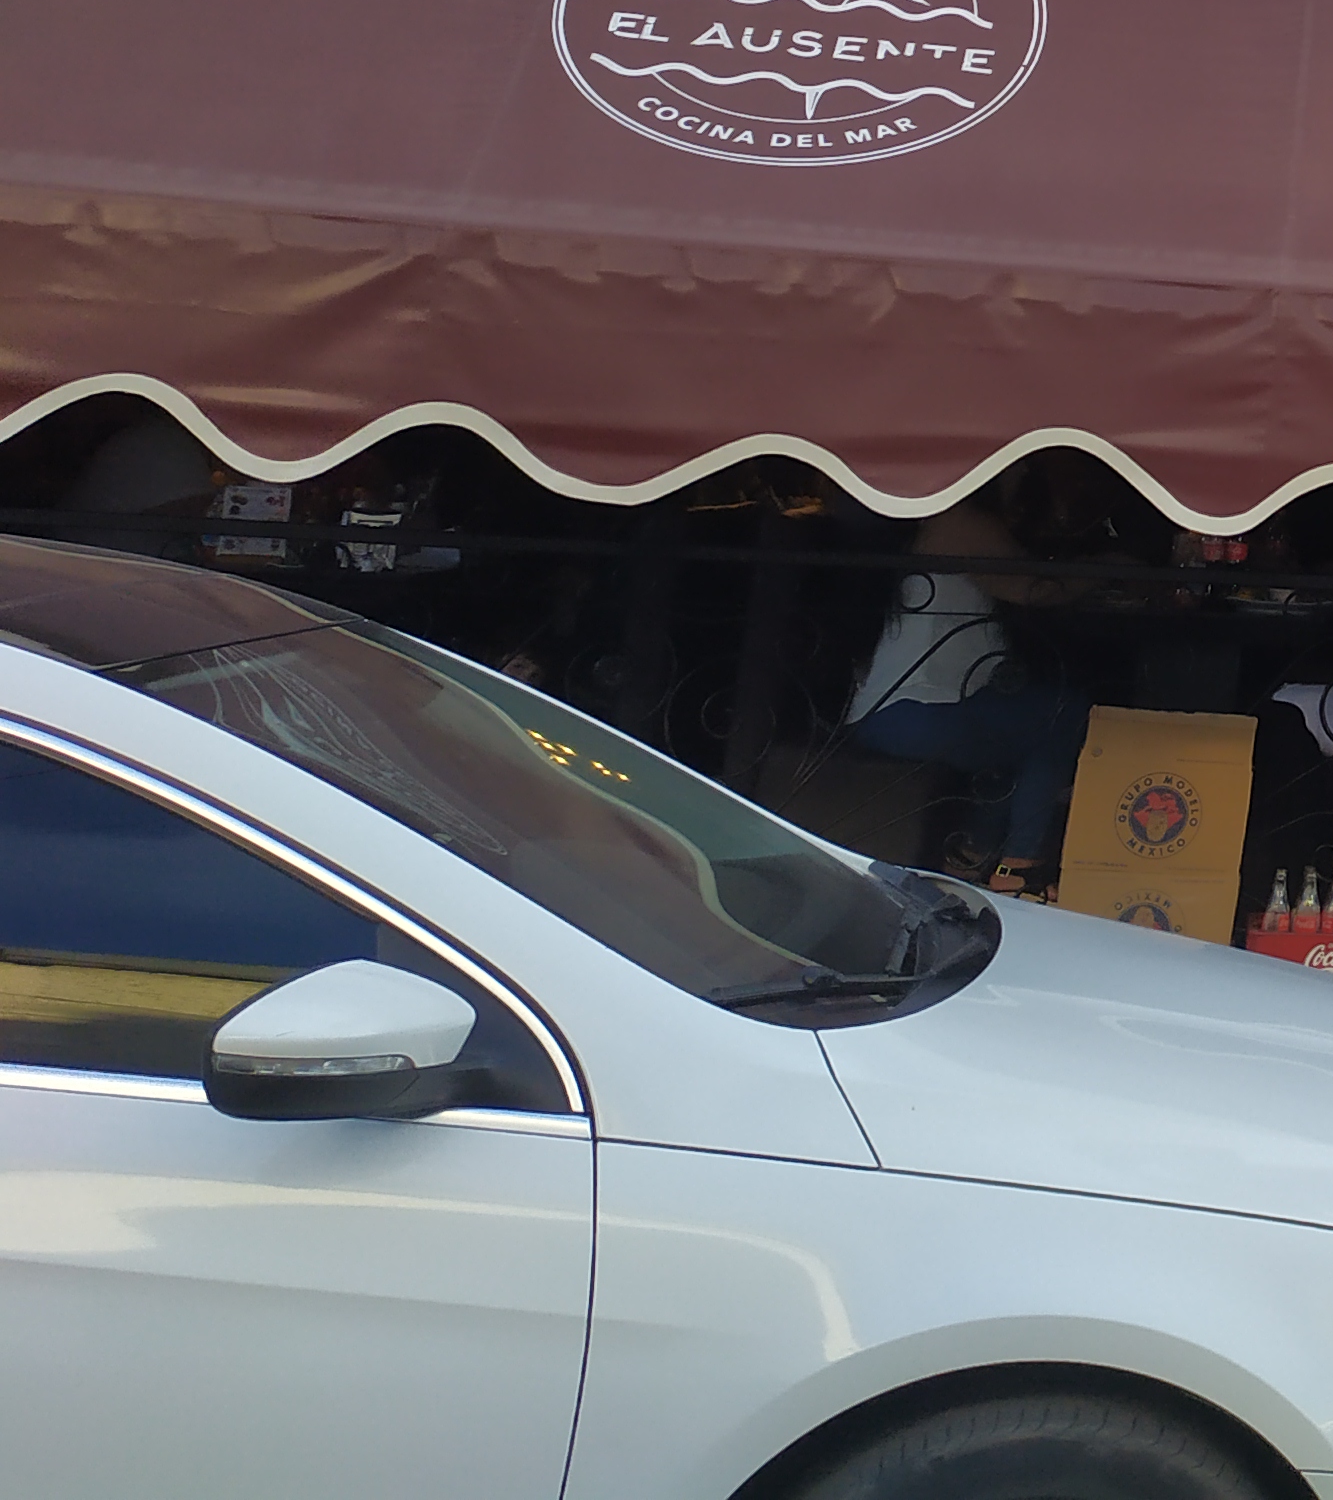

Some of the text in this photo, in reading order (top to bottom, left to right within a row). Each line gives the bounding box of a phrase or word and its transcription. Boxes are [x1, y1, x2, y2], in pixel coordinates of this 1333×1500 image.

[607, 11, 996, 74] EL AUSENTE
[636, 95, 918, 149] COCINA DEL MAR
[1118, 775, 1199, 827] GRUPO MODELO
[1126, 837, 1186, 857] MEXICO
